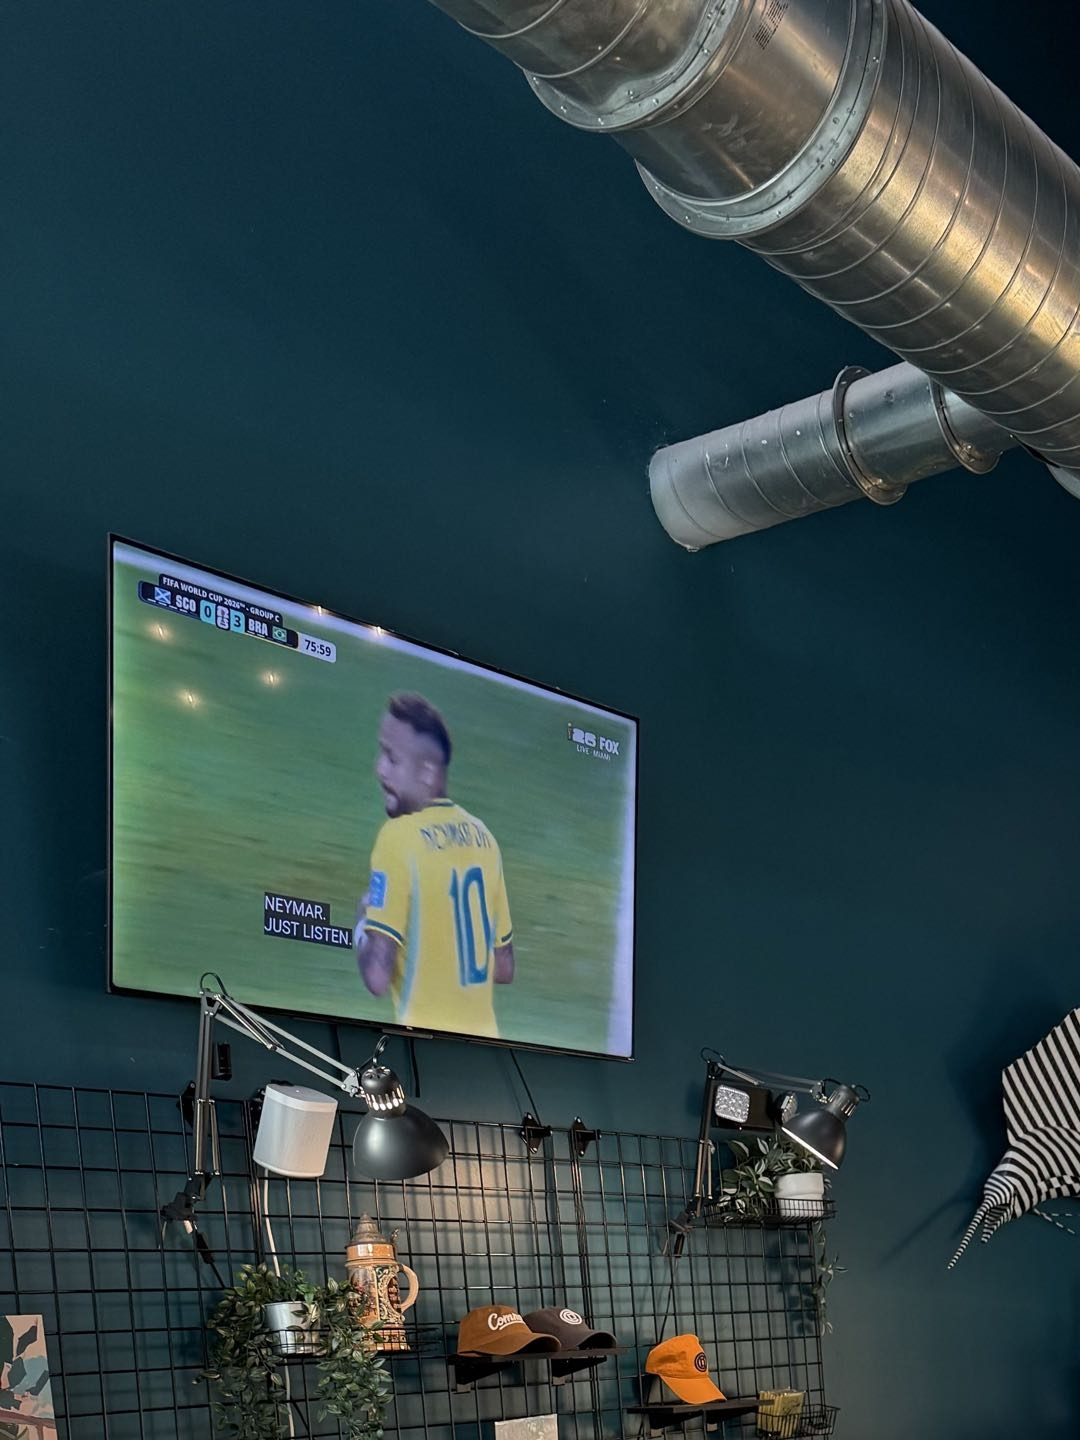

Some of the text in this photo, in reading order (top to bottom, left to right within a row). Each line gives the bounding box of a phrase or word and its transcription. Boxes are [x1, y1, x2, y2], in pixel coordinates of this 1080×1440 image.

[163, 577, 179, 589] FIFA
[180, 582, 208, 598] WORLD
[208, 593, 223, 604] CUP
[250, 606, 274, 620] GROUP
[175, 595, 196, 612] SCO
[204, 605, 212, 618] 0
[233, 614, 242, 627] 3
[248, 618, 268, 636] BRA
[304, 639, 331, 657] 75:59
[600, 736, 618, 755] FOX
[265, 895, 326, 920] NEYMAR.
[264, 917, 352, 945] JUST LISTEN.
[448, 866, 490, 987] 10
